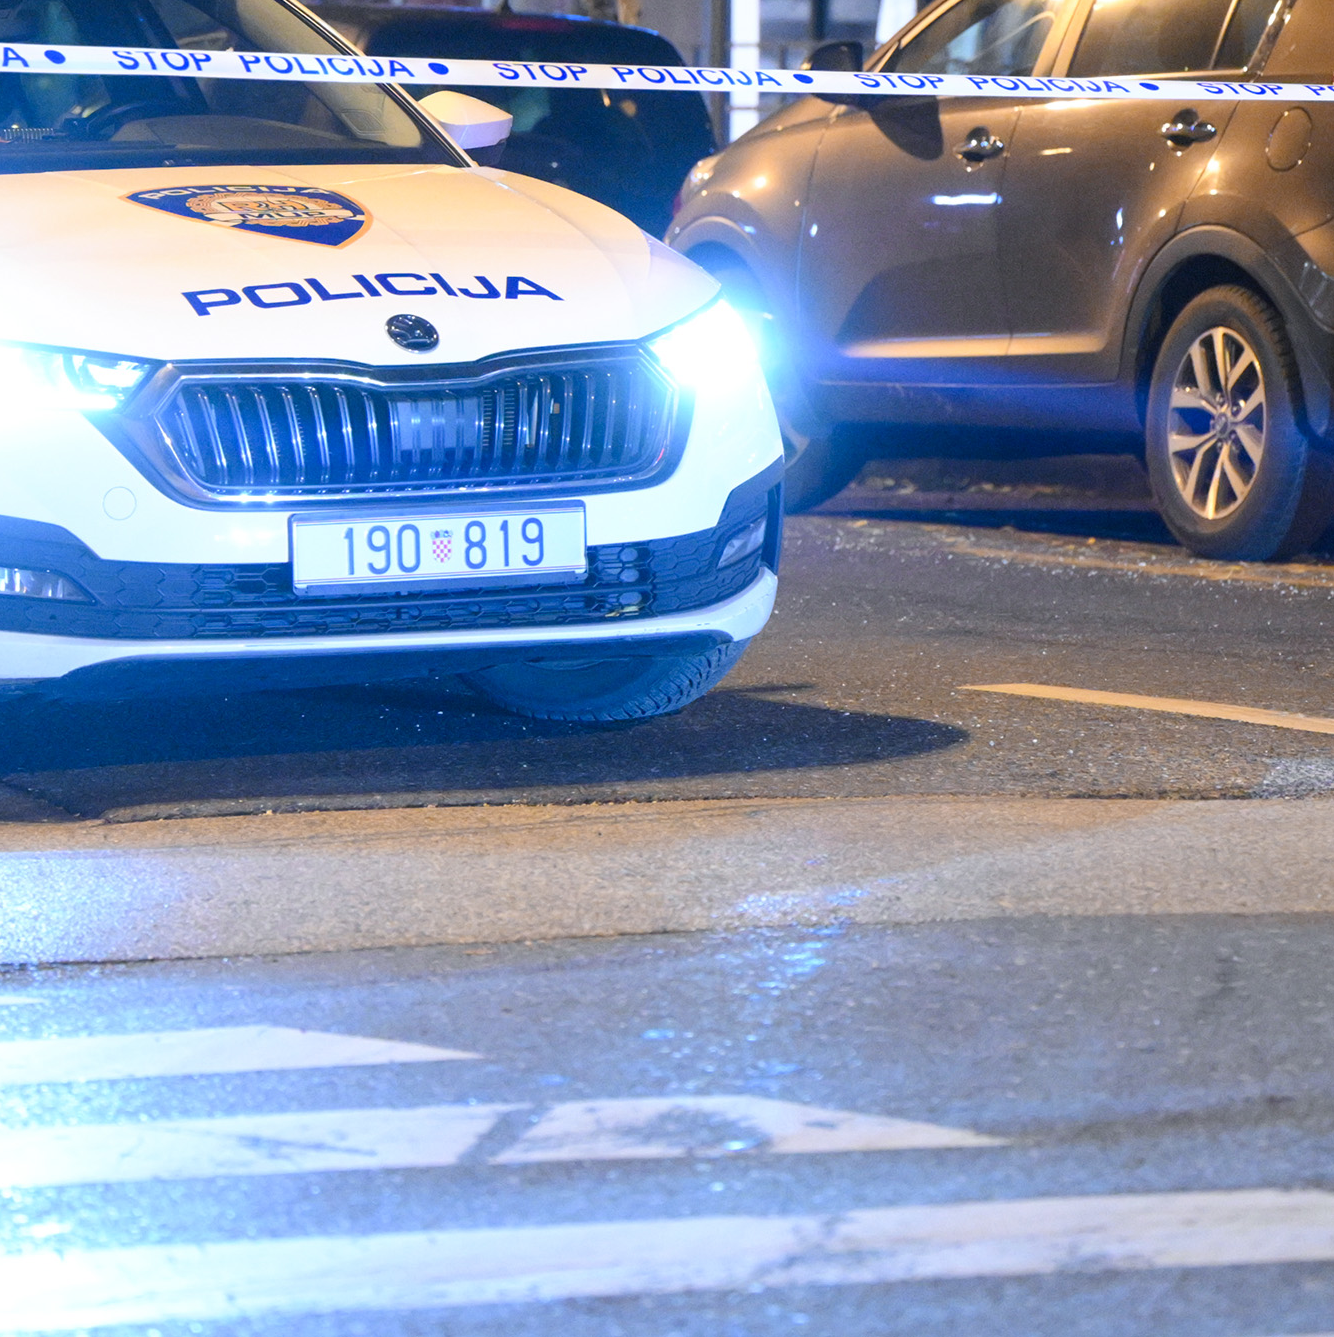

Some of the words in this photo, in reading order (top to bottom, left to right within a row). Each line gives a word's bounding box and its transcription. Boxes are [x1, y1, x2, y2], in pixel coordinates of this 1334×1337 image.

[113, 49, 213, 72] STOP
[239, 54, 415, 78] POLICIJA
[493, 62, 589, 82] STOP
[611, 66, 782, 87] POLICIJA
[853, 73, 945, 89] STOP
[966, 76, 1130, 93] POLICIJA
[1196, 82, 1284, 96] STOP
[138, 185, 332, 200] POLICIJA
[181, 272, 565, 316] POLICIJA
[343, 523, 421, 576] 190
[463, 517, 546, 570] 819
